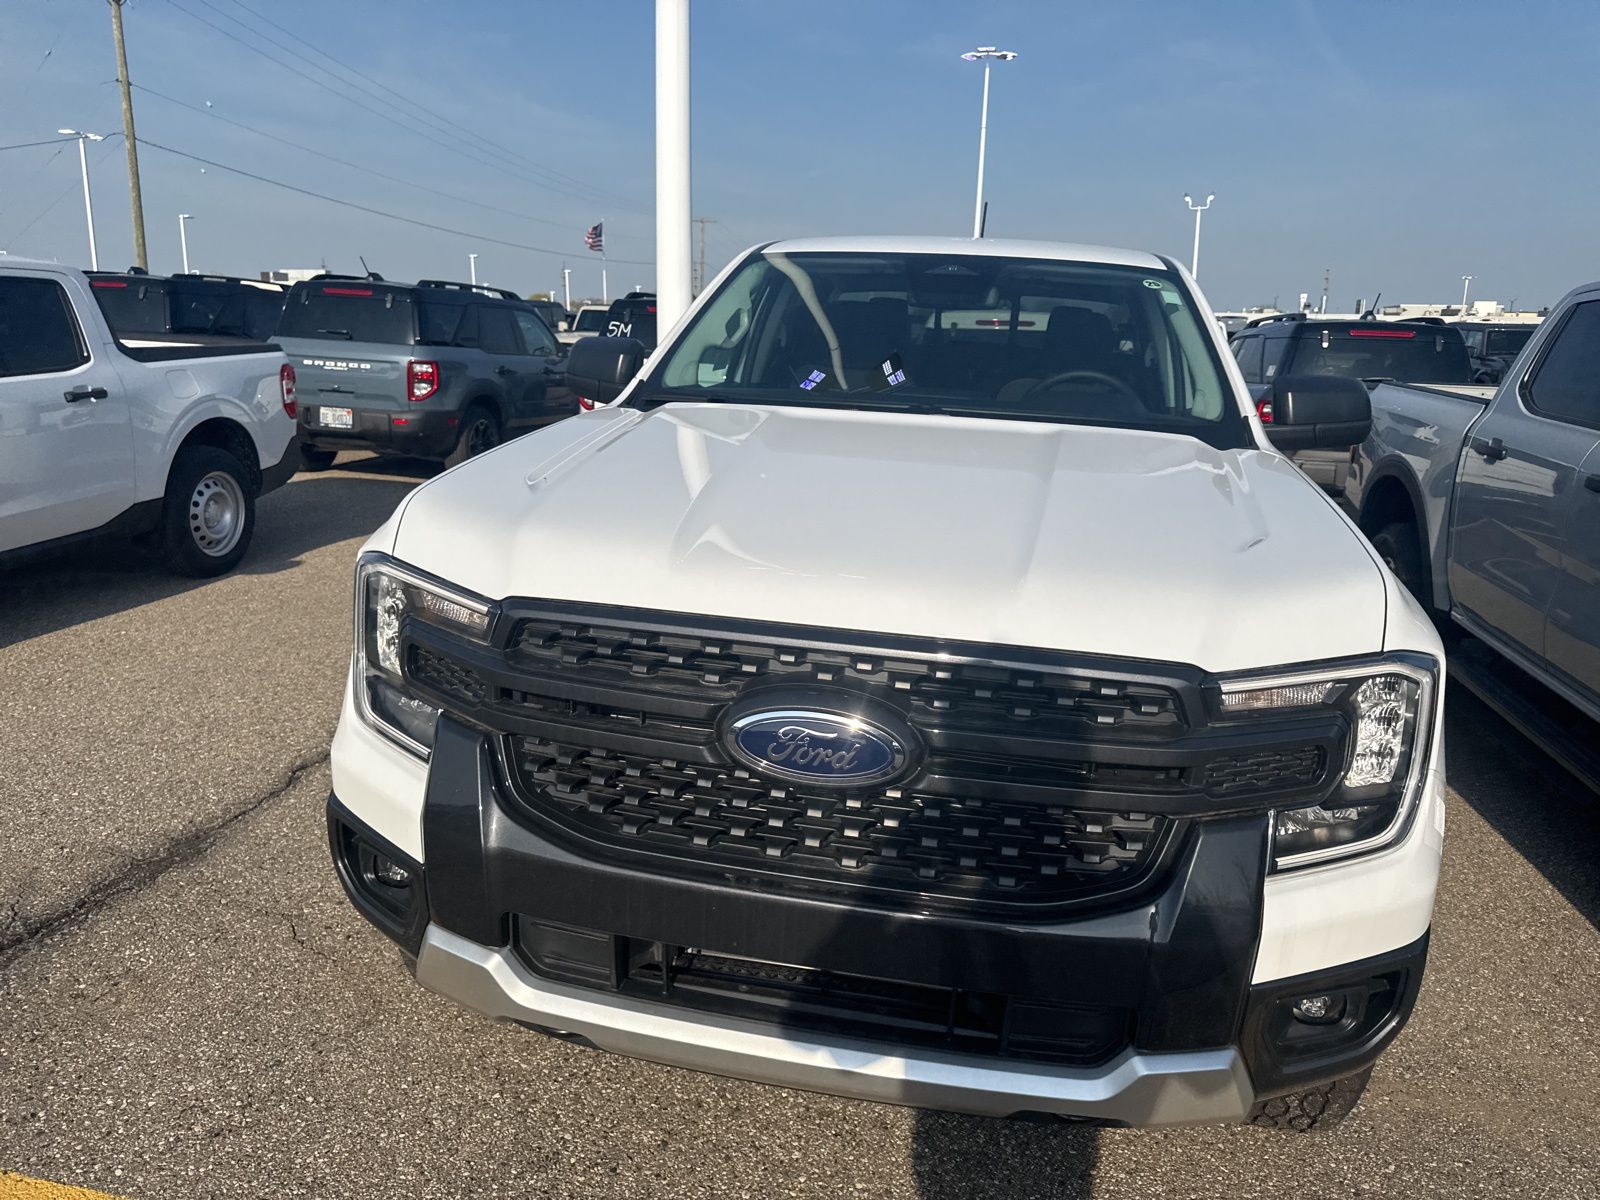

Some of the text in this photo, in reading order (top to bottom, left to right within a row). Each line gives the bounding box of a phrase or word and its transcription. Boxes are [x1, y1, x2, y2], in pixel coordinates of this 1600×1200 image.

[606, 321, 632, 337] 5M
[303, 360, 371, 369] BRONCO
[767, 726, 861, 769] Ford
